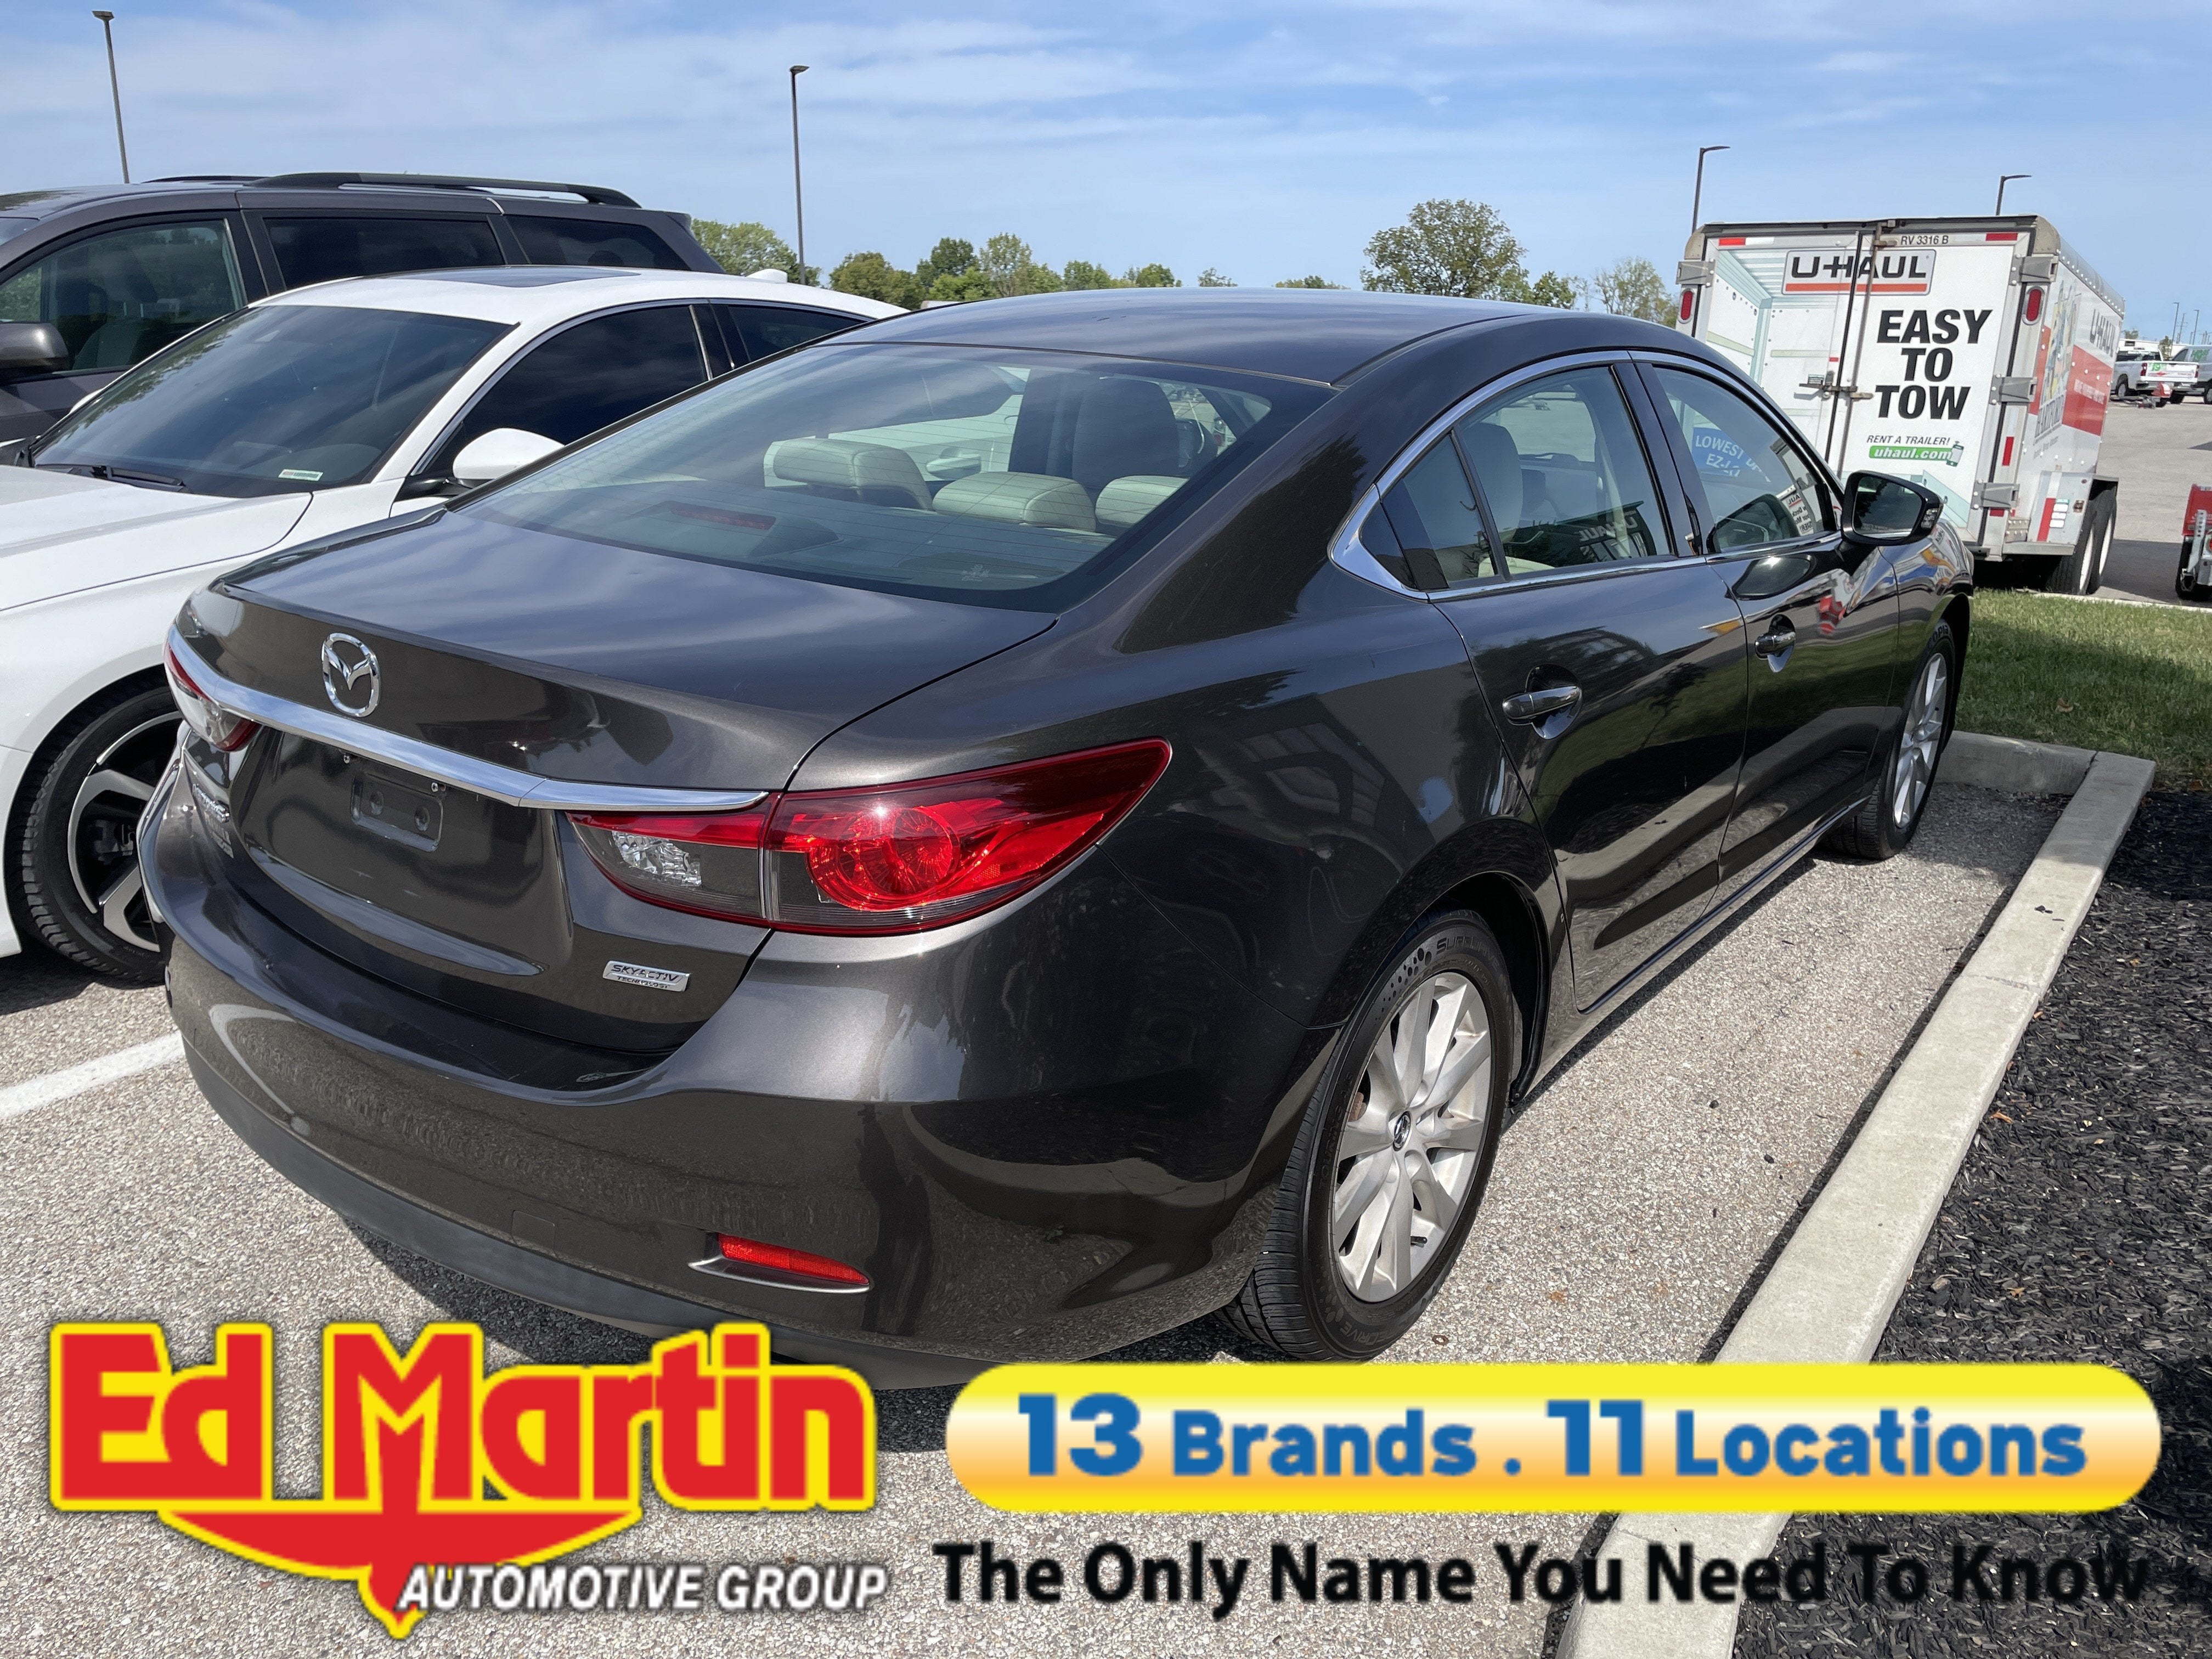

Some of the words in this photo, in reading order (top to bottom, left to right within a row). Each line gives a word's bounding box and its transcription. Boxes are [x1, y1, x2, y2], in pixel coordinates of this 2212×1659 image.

[1901, 236, 1915, 245] RV
[1917, 235, 1939, 245] 3316
[1942, 235, 1949, 245] B
[1791, 255, 1927, 279] U-HAUL
[1877, 309, 1993, 345] EASY
[1901, 347, 1953, 382] TO
[1875, 385, 1971, 420] TOW
[1695, 435, 1744, 460] LOWEST
[1866, 435, 1894, 443] RENT
[1905, 436, 1950, 445] TRAILER!
[1874, 447, 1953, 460] uhaul.com
[611, 964, 679, 981] SKYACTIV
